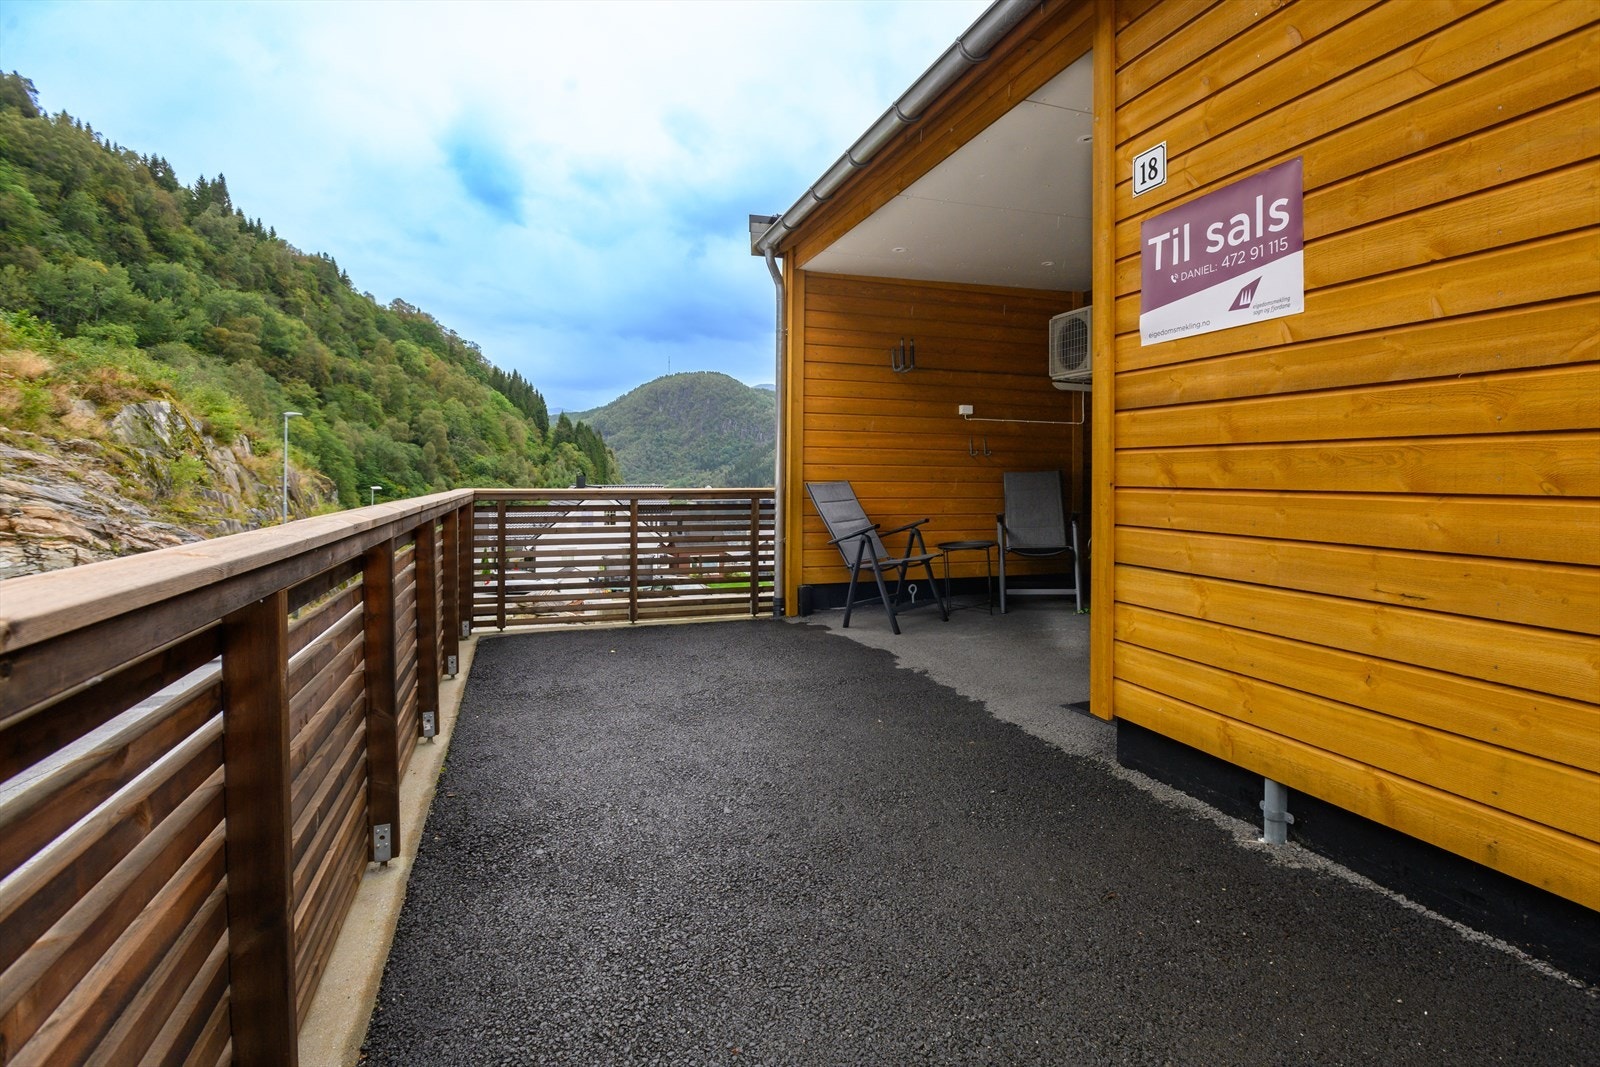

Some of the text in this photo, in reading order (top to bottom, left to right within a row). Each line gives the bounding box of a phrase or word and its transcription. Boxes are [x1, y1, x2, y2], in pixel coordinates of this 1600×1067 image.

[1139, 157, 1158, 186] 18
[1148, 194, 1289, 271] Til sals
[1180, 236, 1289, 282] DANIEL: 472 91 115
[1252, 296, 1291, 310] eigedomsmekling
[1148, 319, 1211, 339] eigedomsmekling.no
